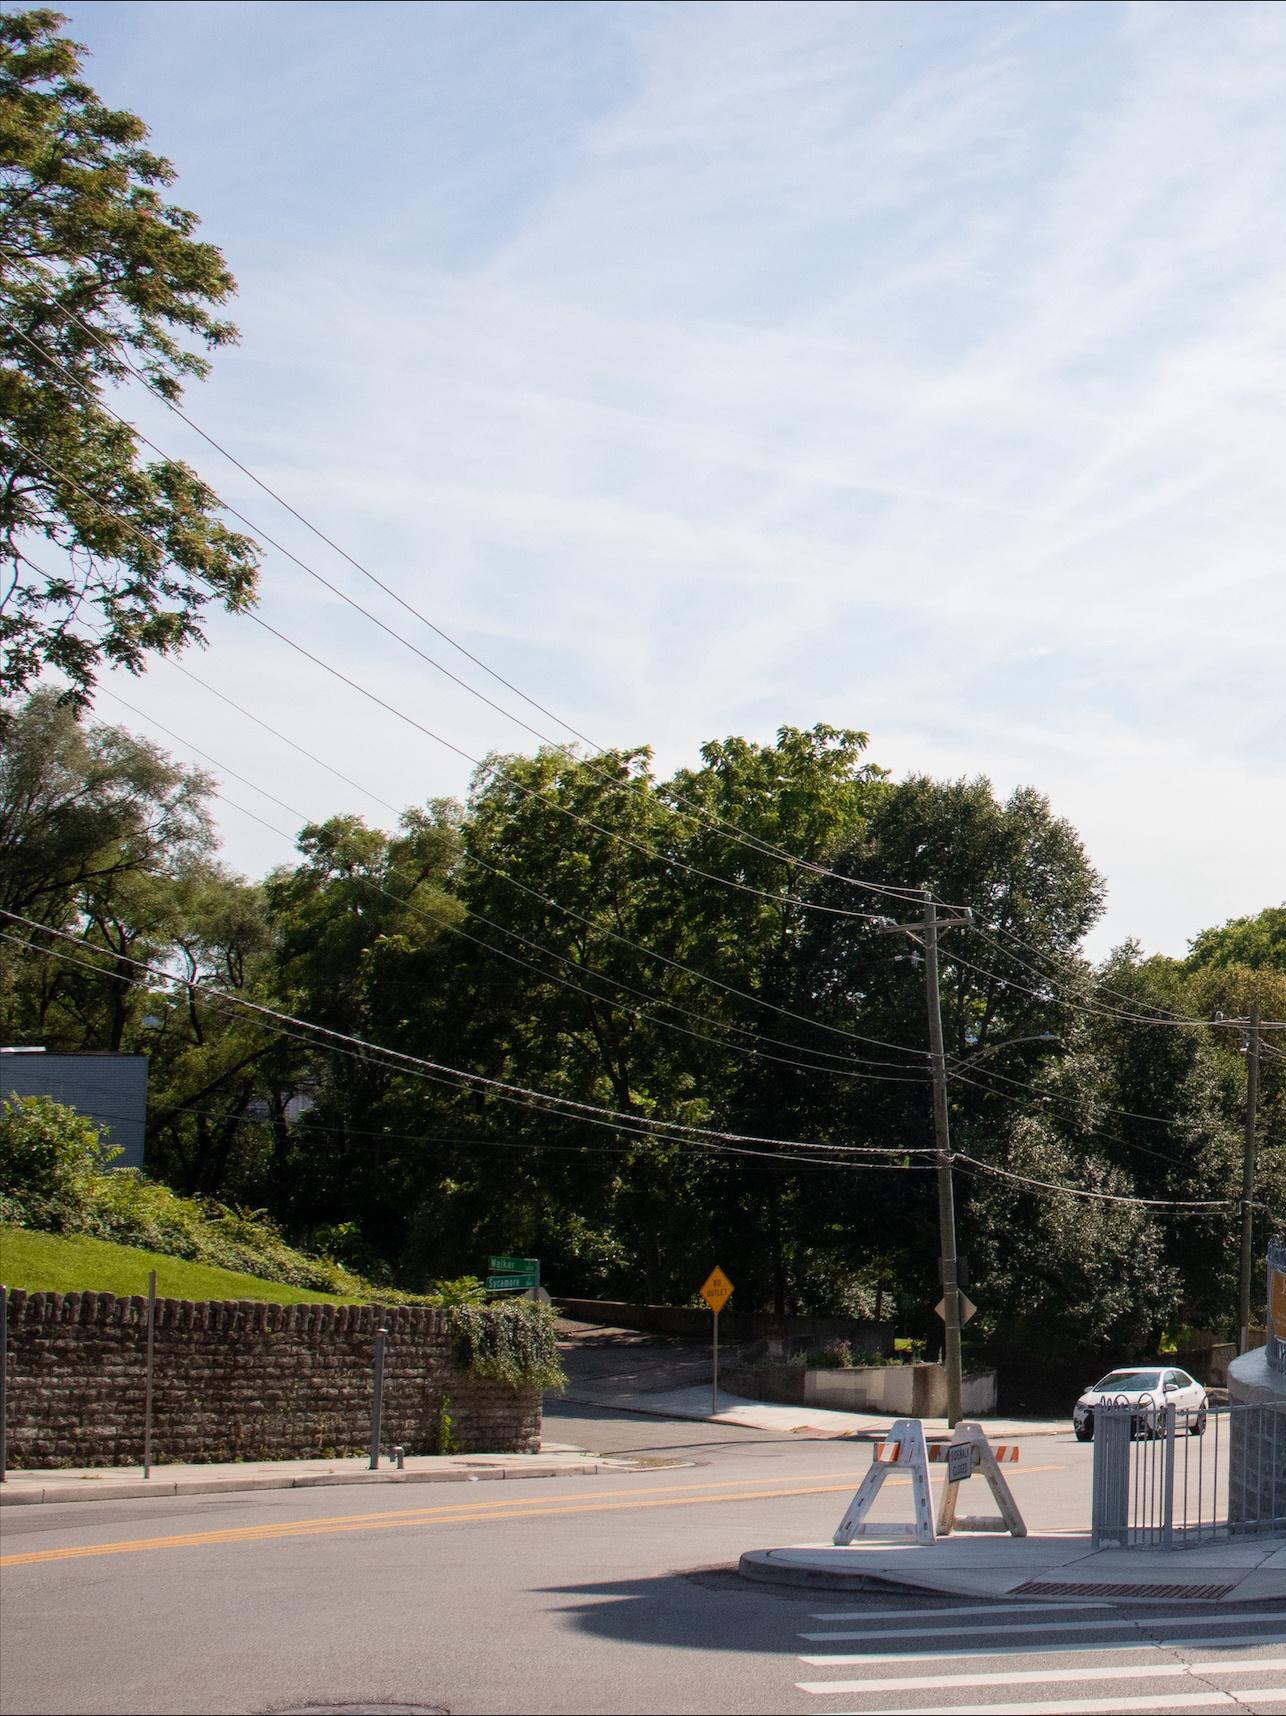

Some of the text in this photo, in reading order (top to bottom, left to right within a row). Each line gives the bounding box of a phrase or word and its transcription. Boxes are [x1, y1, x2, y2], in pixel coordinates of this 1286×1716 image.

[490, 1258, 515, 1270] Walker
[489, 1278, 520, 1290] Sycamore
[712, 1278, 722, 1287] NO
[706, 1287, 727, 1298] OUTLET
[951, 1446, 970, 1461] SIDEWALK
[953, 1462, 968, 1476] CLOSED
